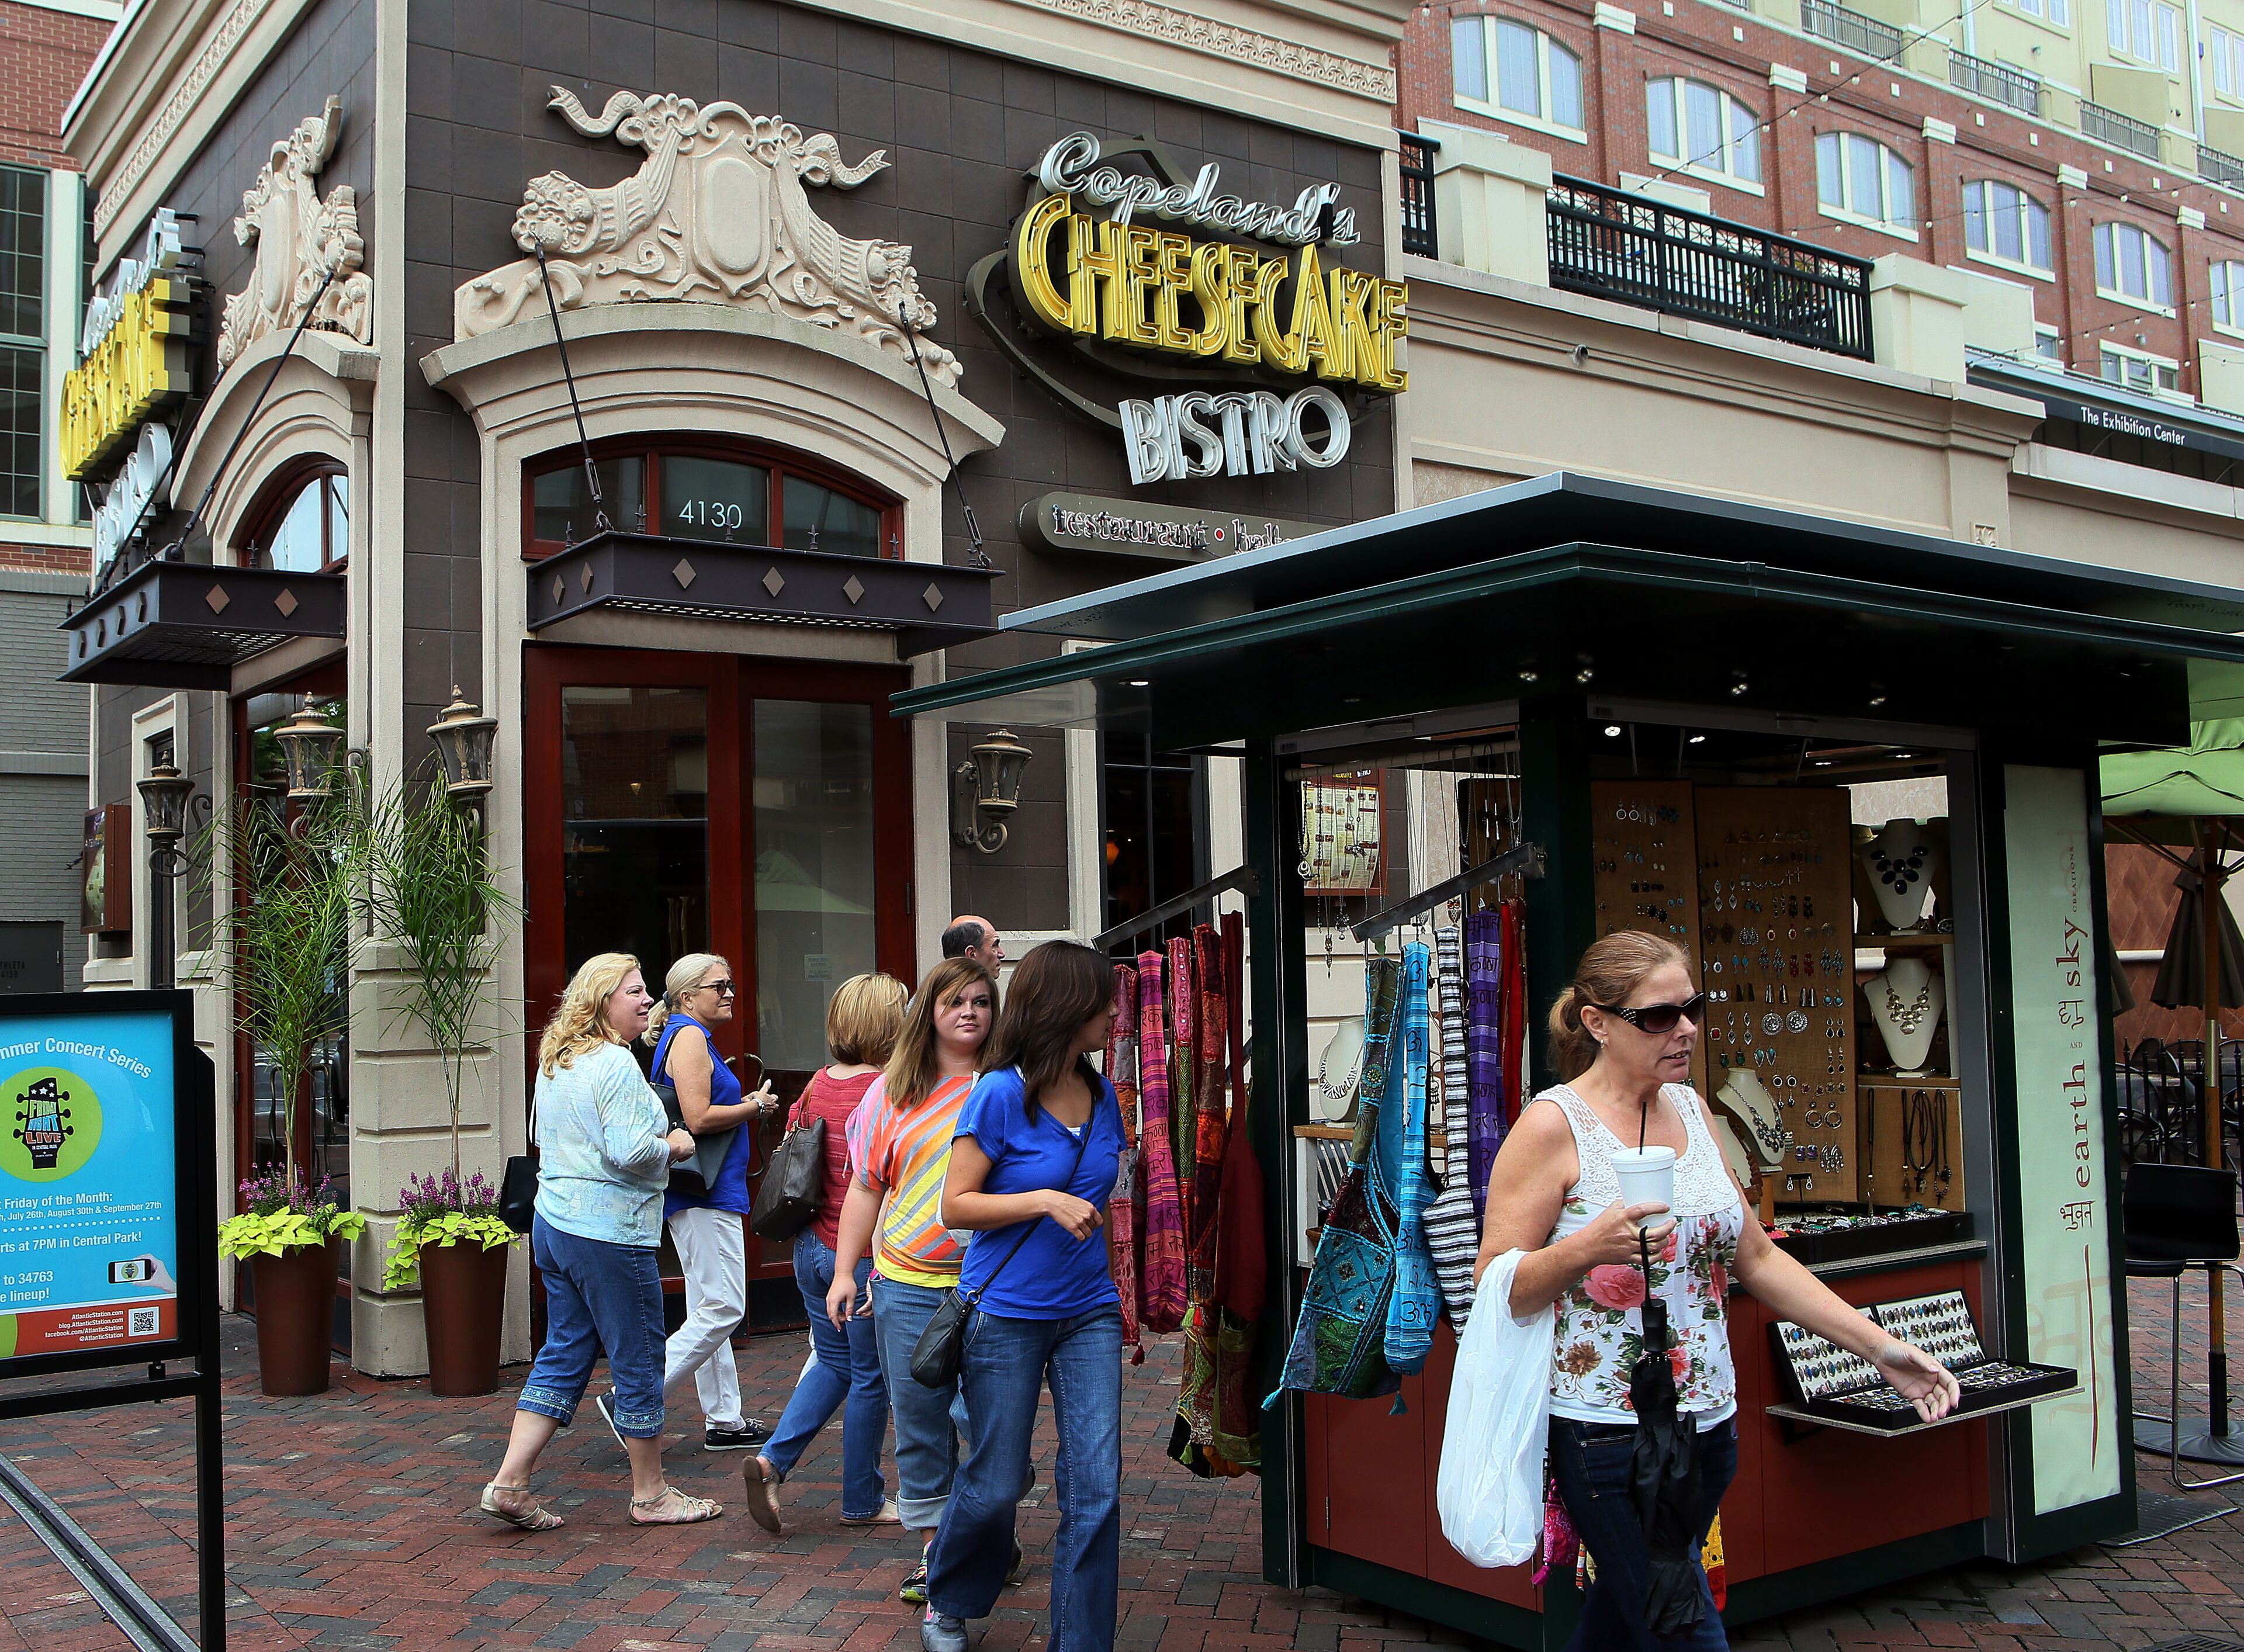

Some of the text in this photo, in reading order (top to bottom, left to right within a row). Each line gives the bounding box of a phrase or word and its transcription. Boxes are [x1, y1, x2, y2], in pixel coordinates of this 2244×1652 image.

[1040, 130, 1360, 245] Copeland's
[1018, 192, 1409, 393] CHEESECAKE
[1118, 386, 1351, 485] BISTRO
[2080, 406, 2186, 446] The Exhibition Center
[678, 499, 742, 529] 4130
[1051, 505, 1210, 549] restaurant
[2069, 846, 2077, 913] CREATIONS
[2056, 916, 2089, 987] sky
[45, 1037, 106, 1059] Concert
[107, 1048, 152, 1079] Series
[2062, 1059, 2091, 1188] earth
[25, 1131, 61, 1144] LIVE
[4, 1197, 39, 1210] Friday
[41, 1195, 53, 1207] of
[55, 1194, 73, 1206] the
[75, 1192, 113, 1204] Month:
[7, 1211, 25, 1221] July
[26, 1210, 46, 1219] 26th,
[47, 1207, 75, 1218] August
[76, 1206, 94, 1215] 30th
[95, 1206, 102, 1214] &
[103, 1203, 144, 1214] September
[145, 1201, 162, 1210] 27th
[18, 1241, 30, 1252] at
[32, 1238, 57, 1251] 7PM
[60, 1237, 70, 1248] in
[73, 1234, 111, 1246] Central
[114, 1231, 141, 1244] Park!
[3, 1270, 54, 1286] to 34763
[10, 1287, 50, 1302] lineup!
[58, 1318, 124, 1329] blog.AtlanticStation.com
[71, 1310, 124, 1320] AtlanticStation.com
[45, 1325, 124, 1338] facebook.com/AtlanticStation
[79, 1332, 124, 1342] @AtlanticStation
